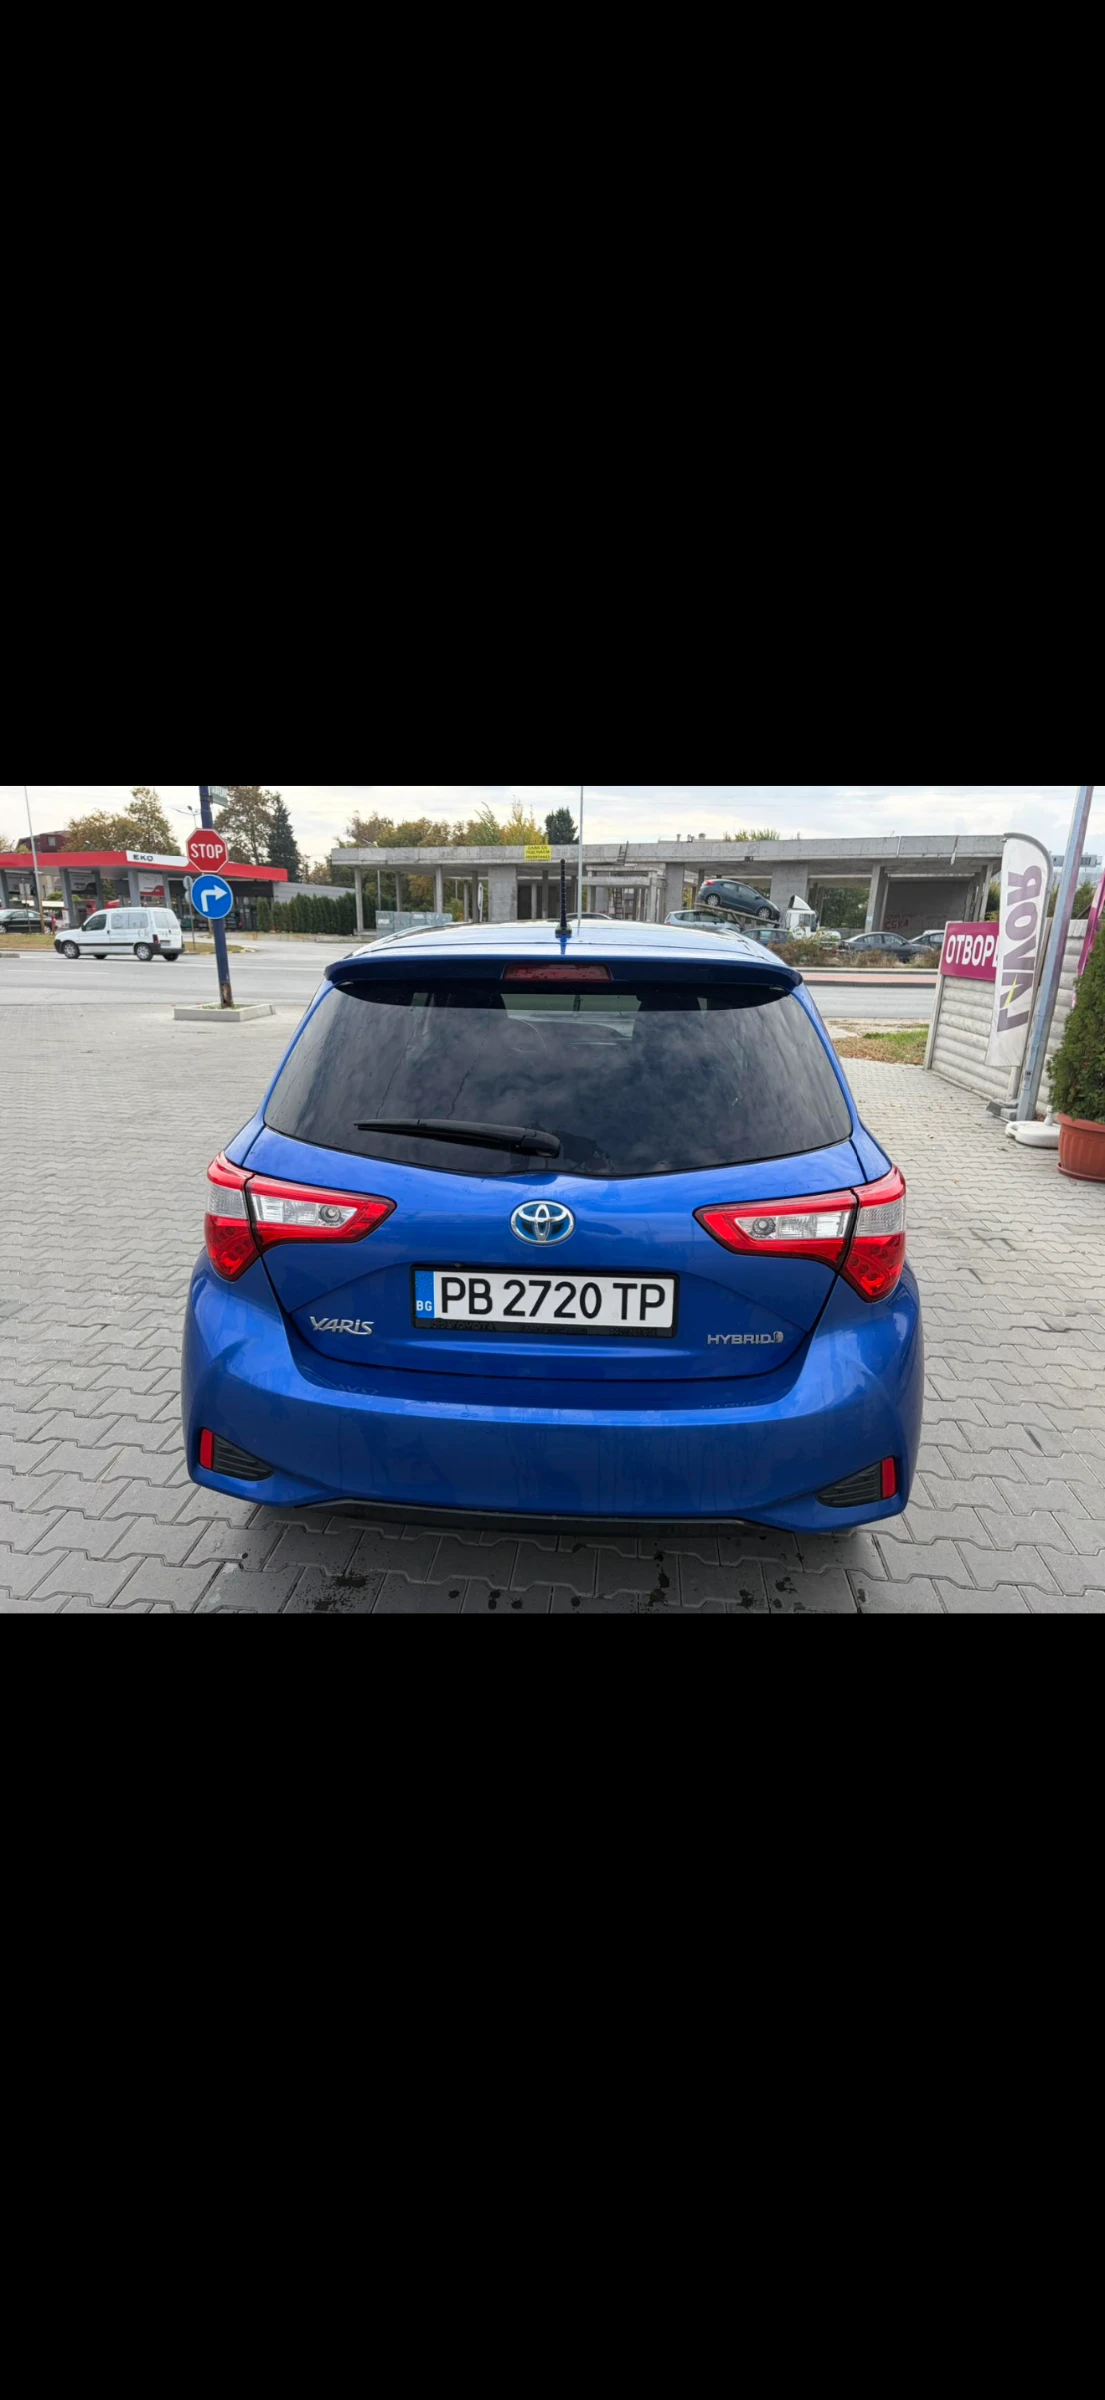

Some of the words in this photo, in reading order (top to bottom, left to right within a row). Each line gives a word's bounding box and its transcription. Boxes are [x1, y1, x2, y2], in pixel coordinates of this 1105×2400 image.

[190, 843, 224, 859] STOP
[132, 854, 154, 862] EKO
[441, 1277, 493, 1315] PB
[503, 1279, 602, 1319] 2720
[612, 1282, 666, 1321] TP
[415, 1300, 433, 1312] BG
[707, 1333, 772, 1344] HYBRID
